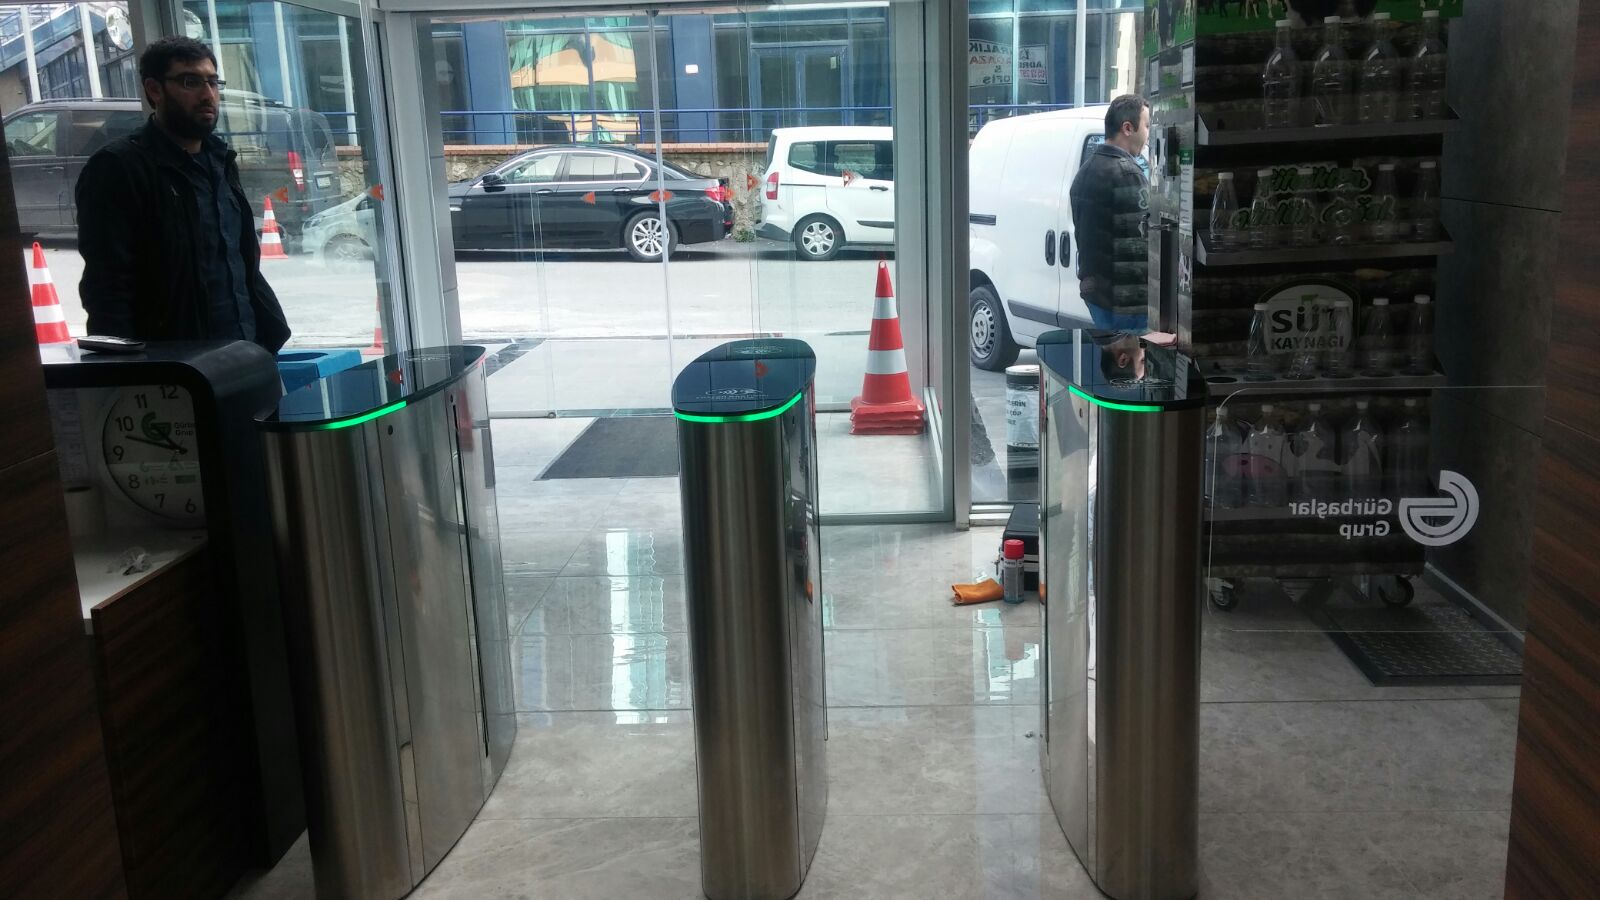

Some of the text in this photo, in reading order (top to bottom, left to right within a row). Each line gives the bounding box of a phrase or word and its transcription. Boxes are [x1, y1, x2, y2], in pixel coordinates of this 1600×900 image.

[1272, 306, 1342, 333] SÜT
[160, 384, 178, 399] 12
[135, 394, 148, 409] 11
[115, 416, 135, 432] 10
[113, 445, 124, 461] 9
[129, 474, 140, 489] 8
[154, 493, 166, 508] 7
[185, 499, 196, 513] 6
